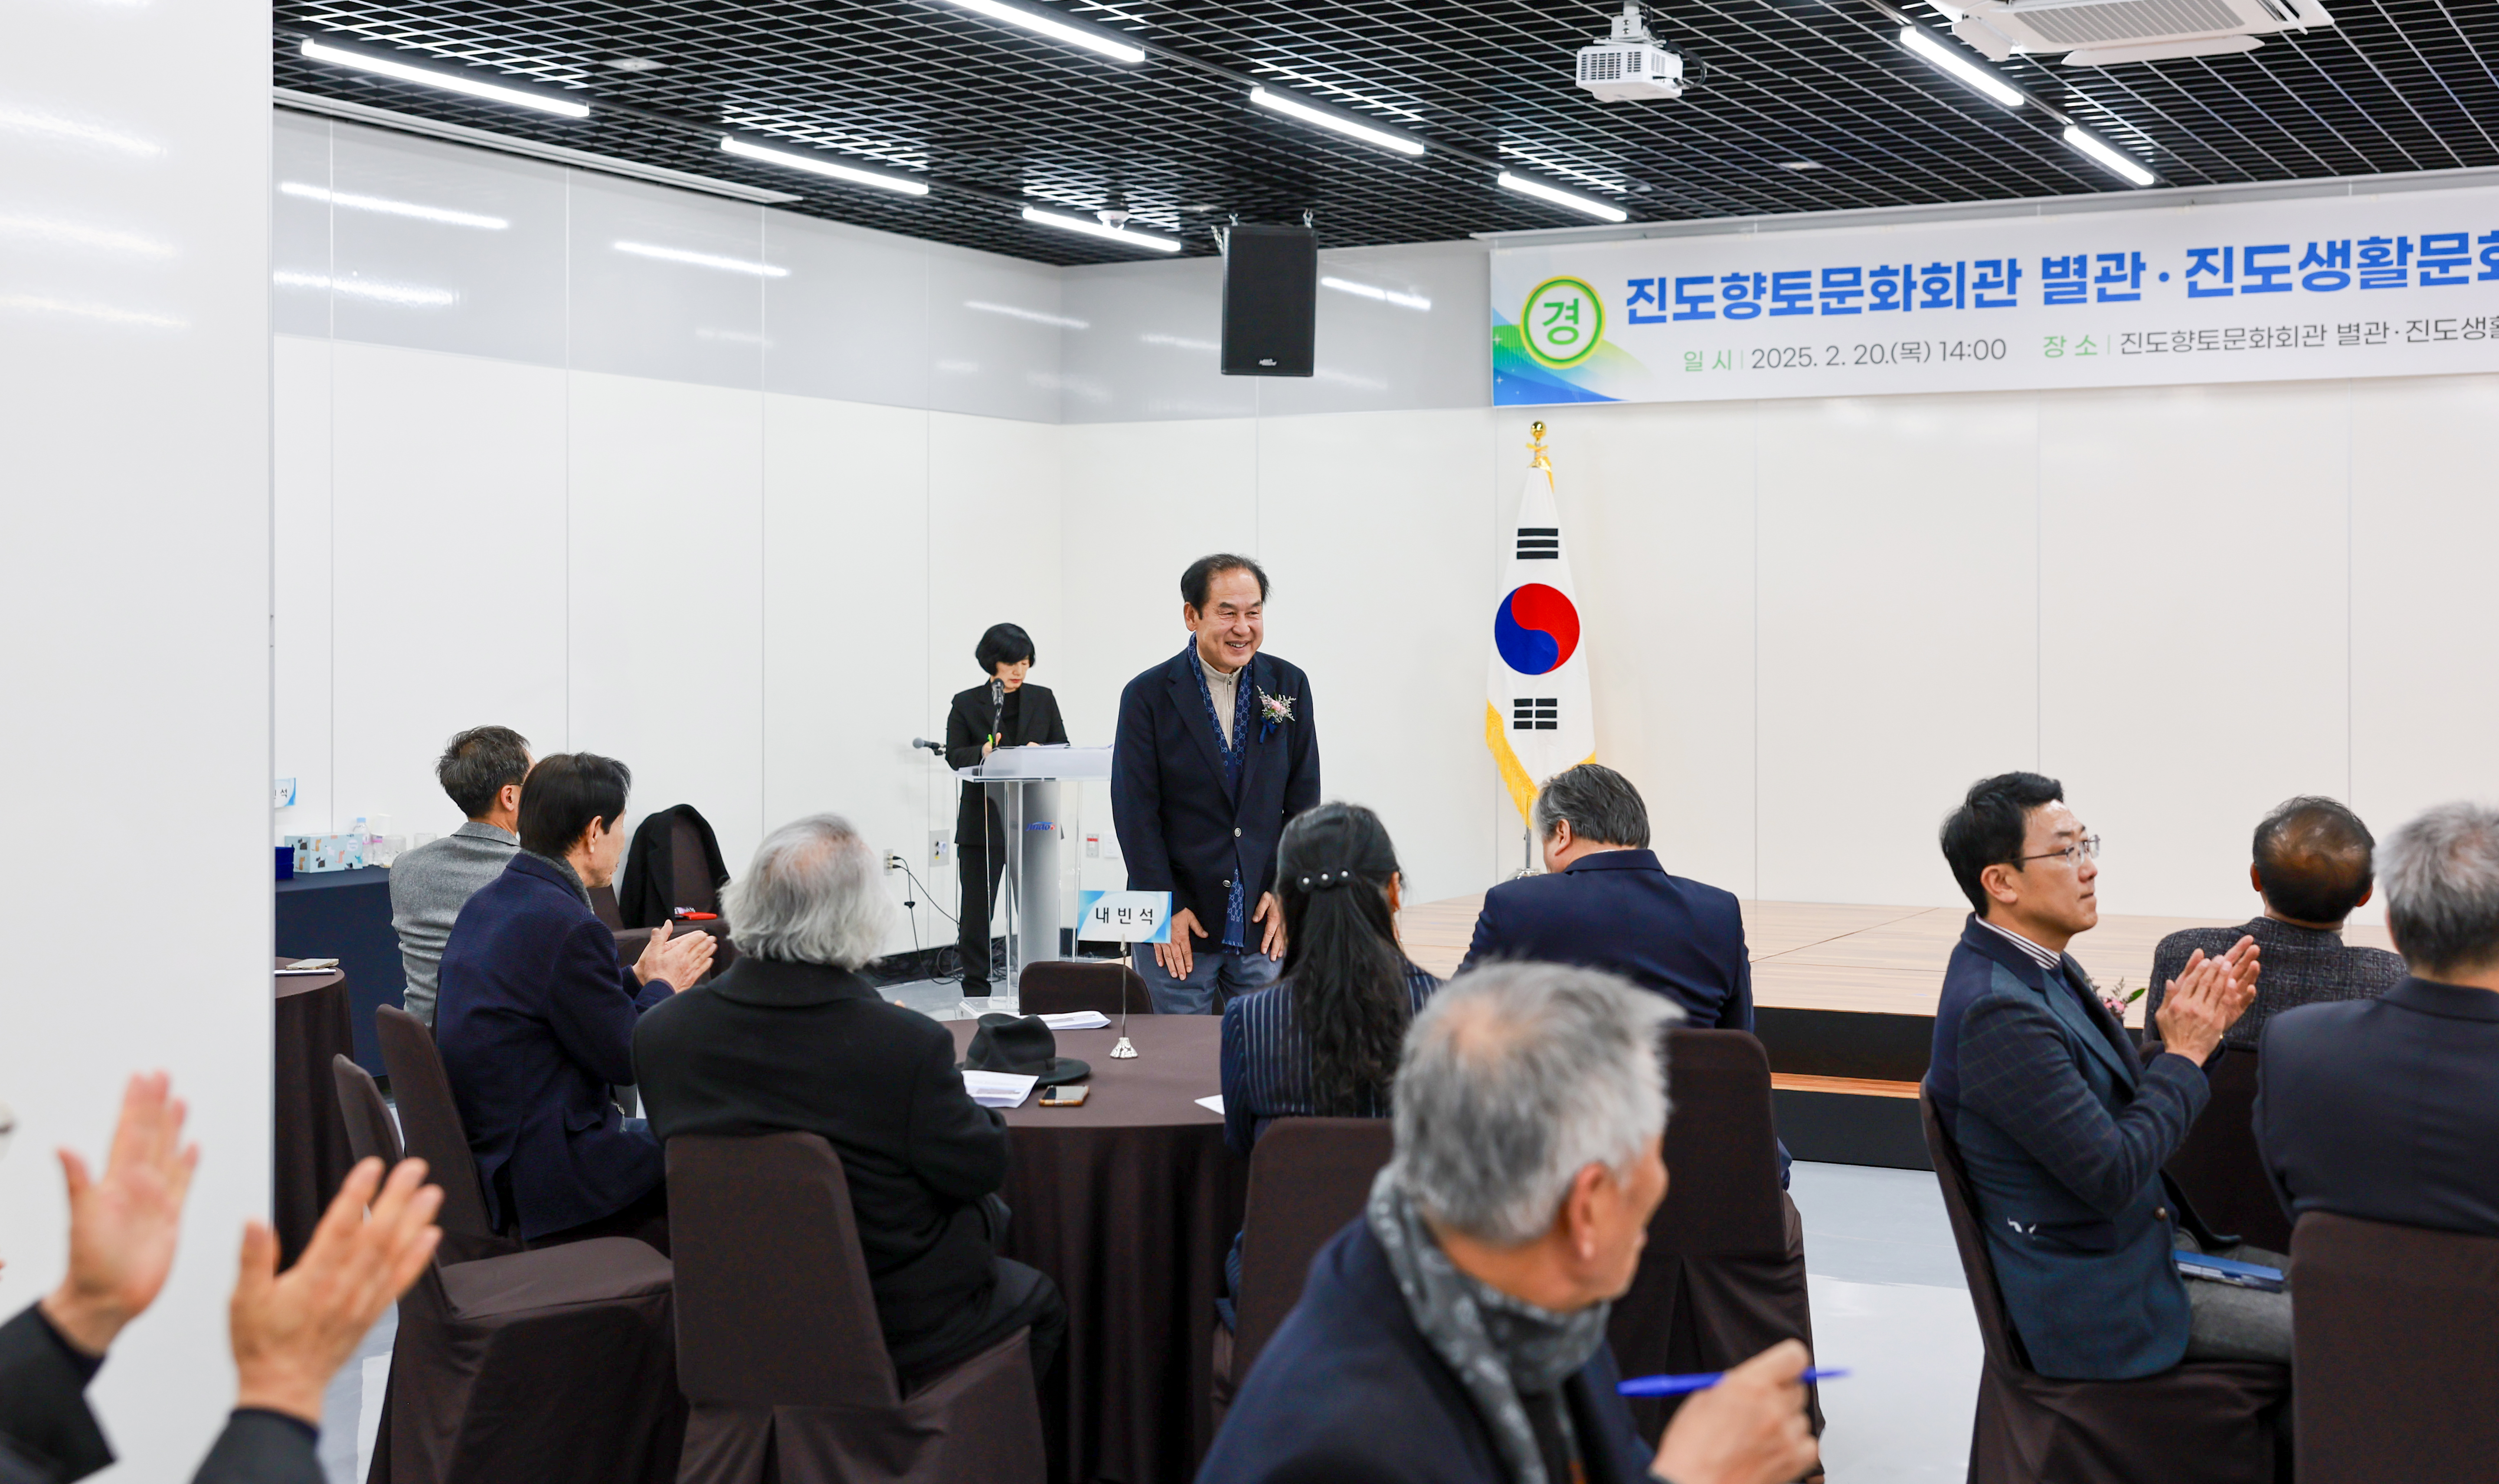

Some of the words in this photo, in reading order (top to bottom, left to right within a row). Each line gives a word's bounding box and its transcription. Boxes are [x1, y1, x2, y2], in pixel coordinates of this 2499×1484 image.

[1626, 258, 2022, 325] 진도향토문화회관
[1542, 298, 1580, 346] 경
[2120, 324, 2327, 355] 진도향토문화회관
[1752, 347, 1817, 369] 2025.
[1826, 345, 1845, 366] 2.
[1939, 339, 2007, 361] 14:00
